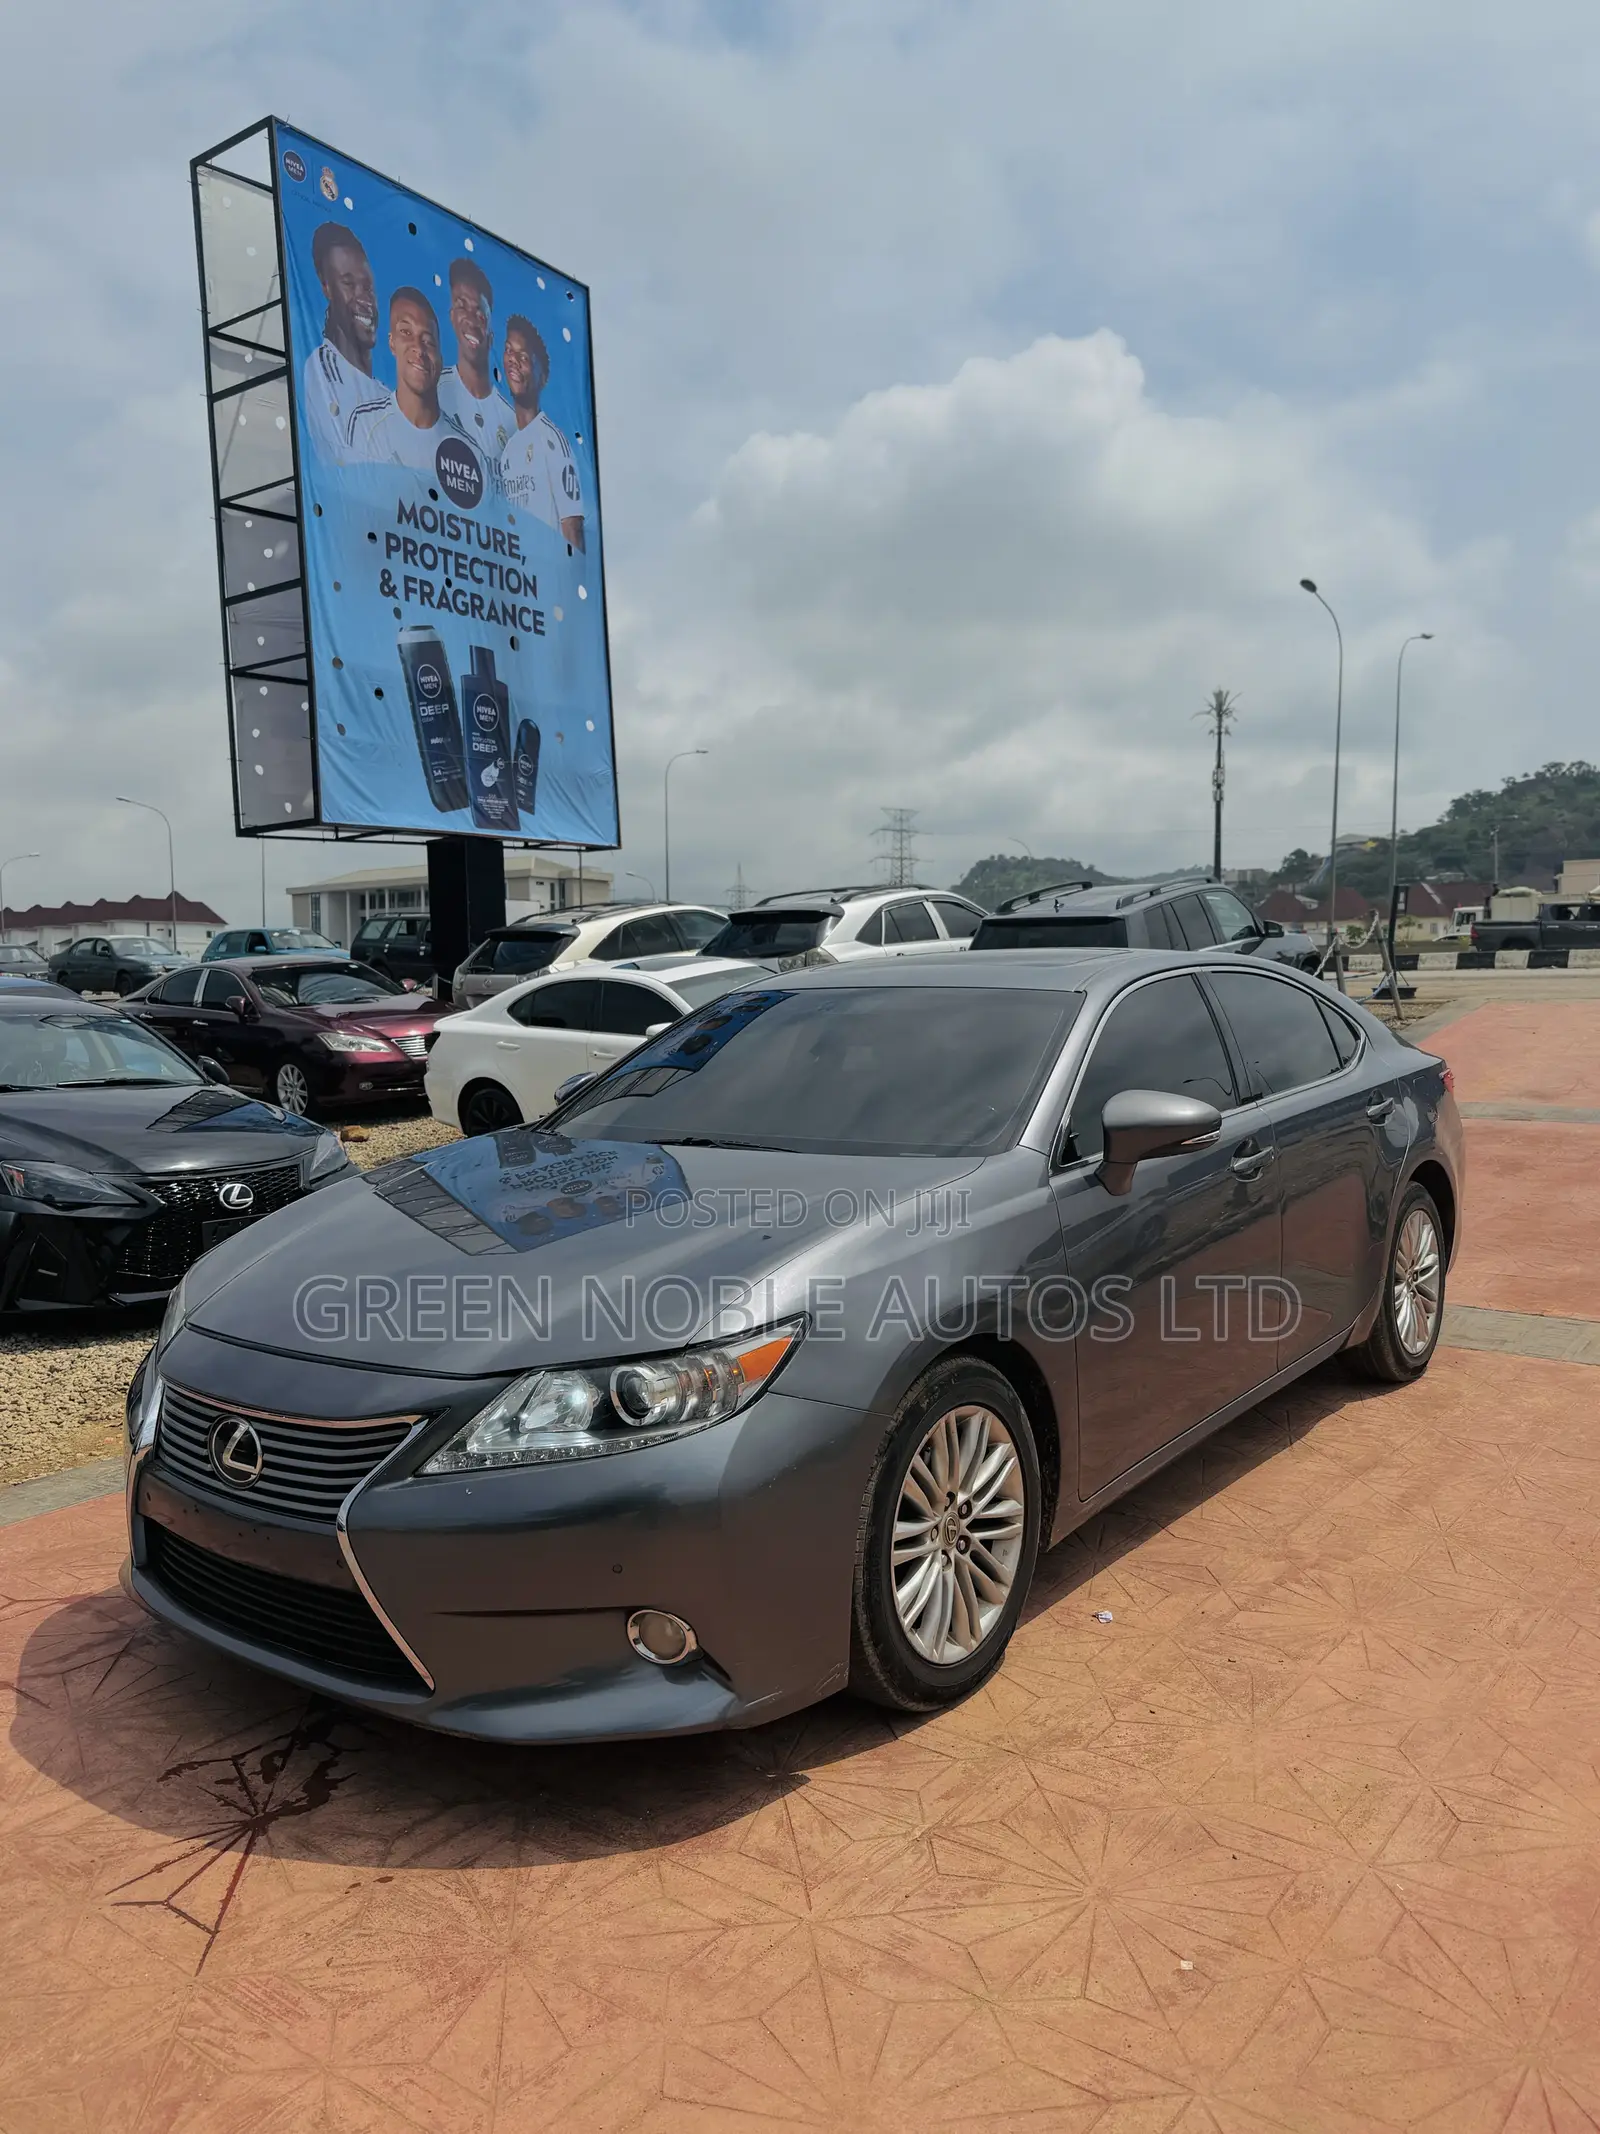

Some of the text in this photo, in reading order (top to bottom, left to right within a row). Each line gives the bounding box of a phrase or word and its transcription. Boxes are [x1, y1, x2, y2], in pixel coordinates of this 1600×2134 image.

[285, 157, 304, 172] NIVEA
[287, 165, 302, 177] MEN
[440, 455, 480, 483] NIVEA
[446, 474, 475, 495] MEN
[397, 496, 527, 567] MOISTURE,
[385, 531, 538, 601] PROTECTION
[379, 568, 546, 637] & FRAGRANCE
[420, 675, 439, 684] NIVEA
[424, 682, 438, 690] MEN
[420, 703, 450, 717] DEEP
[476, 705, 496, 716] NIVEA
[479, 714, 494, 723] MEN
[472, 742, 498, 754] DEEP
